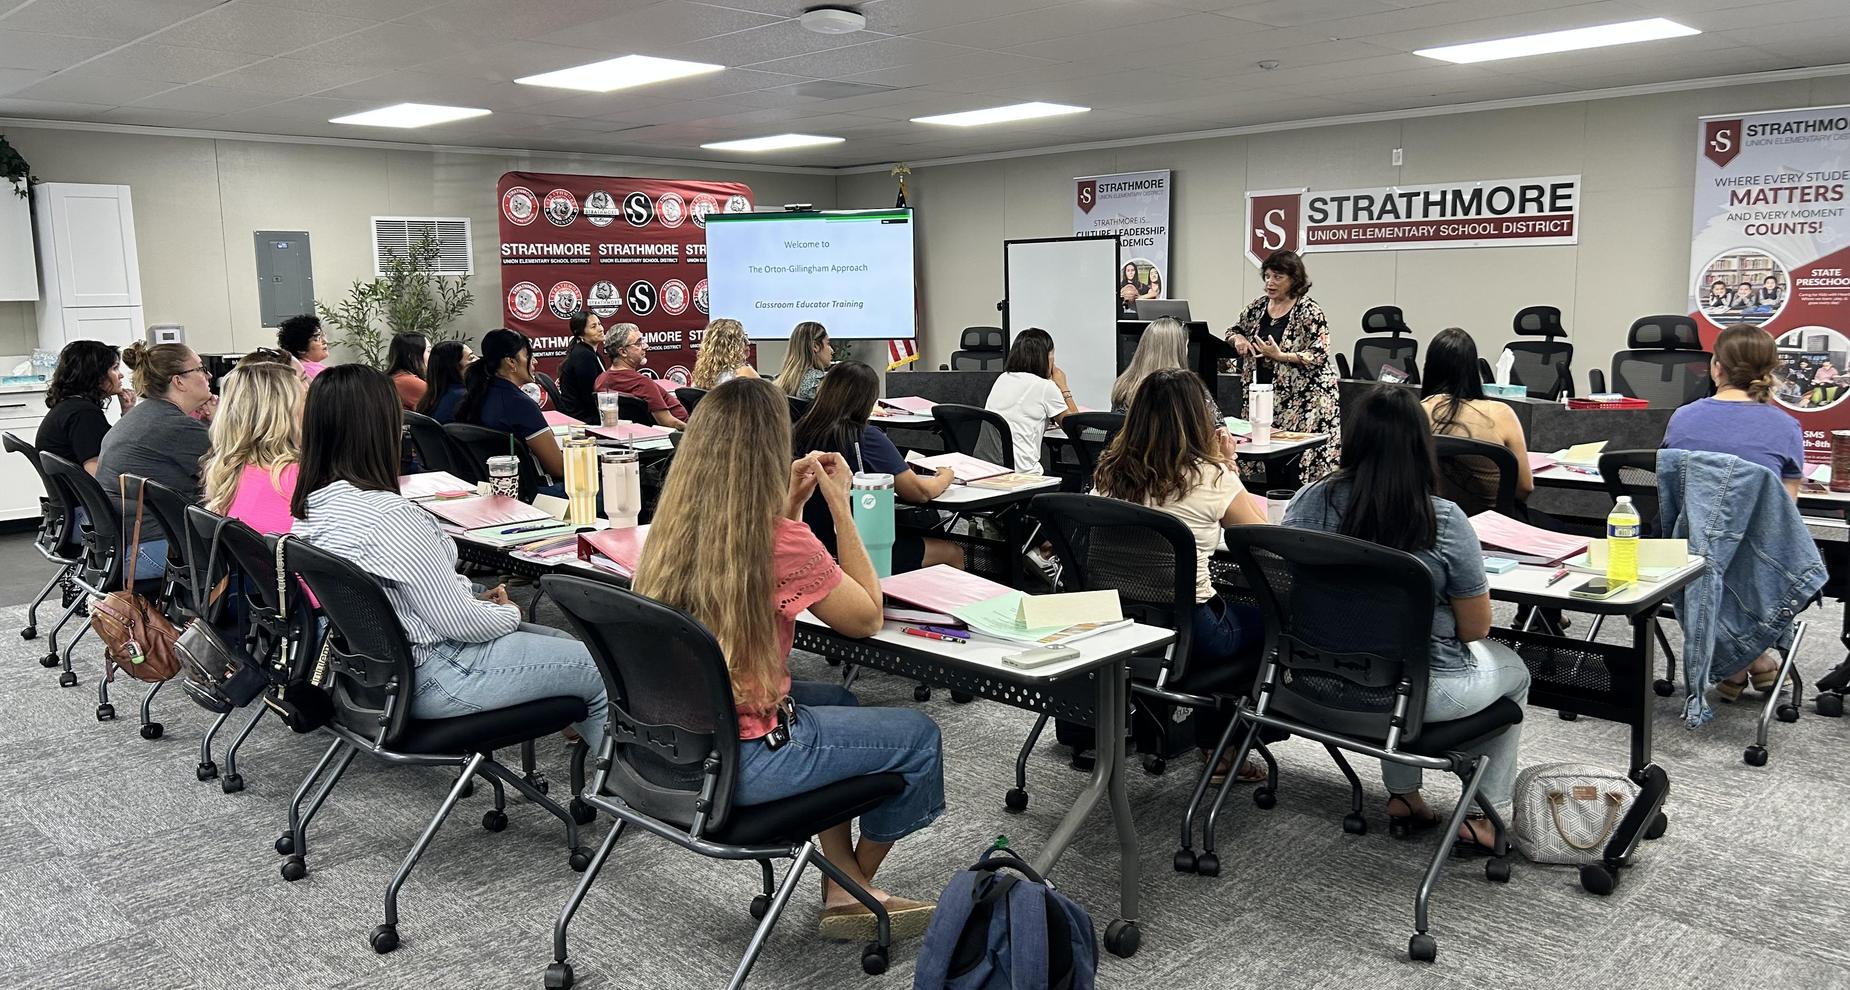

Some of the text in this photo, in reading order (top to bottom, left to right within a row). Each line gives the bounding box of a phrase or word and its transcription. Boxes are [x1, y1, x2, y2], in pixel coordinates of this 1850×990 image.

[1747, 117, 1850, 137] STRATHMO
[1714, 129, 1732, 152] S
[1745, 138, 1773, 147] UNION
[1833, 132, 1850, 141] DIST
[1715, 170, 1850, 187] WHERE EVERY STUDE
[1098, 179, 1164, 193] STRATHMORE
[1729, 184, 1844, 206] MATTERS
[629, 195, 648, 223] S
[1307, 182, 1574, 224] STRATHMORE
[1727, 208, 1845, 221] AND EVERY MOMENT
[1094, 217, 1138, 227] STRATHMORE
[1744, 221, 1823, 236] COUNTS!
[1261, 209, 1287, 250] S
[1309, 219, 1571, 241] UNION ELEMENTARY SCHOOL DISTRICT
[501, 243, 591, 256] STRATHMORE
[598, 243, 679, 256] STRATHMORE
[784, 240, 830, 249] Welcome to
[748, 264, 868, 274] The Orton-Gillingham Approach
[1811, 268, 1842, 277] STATE
[1796, 277, 1850, 286] PRESCHOO
[633, 284, 651, 312] S
[755, 300, 864, 309] Classroom Educator Training
[641, 331, 682, 343] HMORE
[1803, 430, 1825, 439] SMS
[1802, 440, 1831, 448] th-8th
